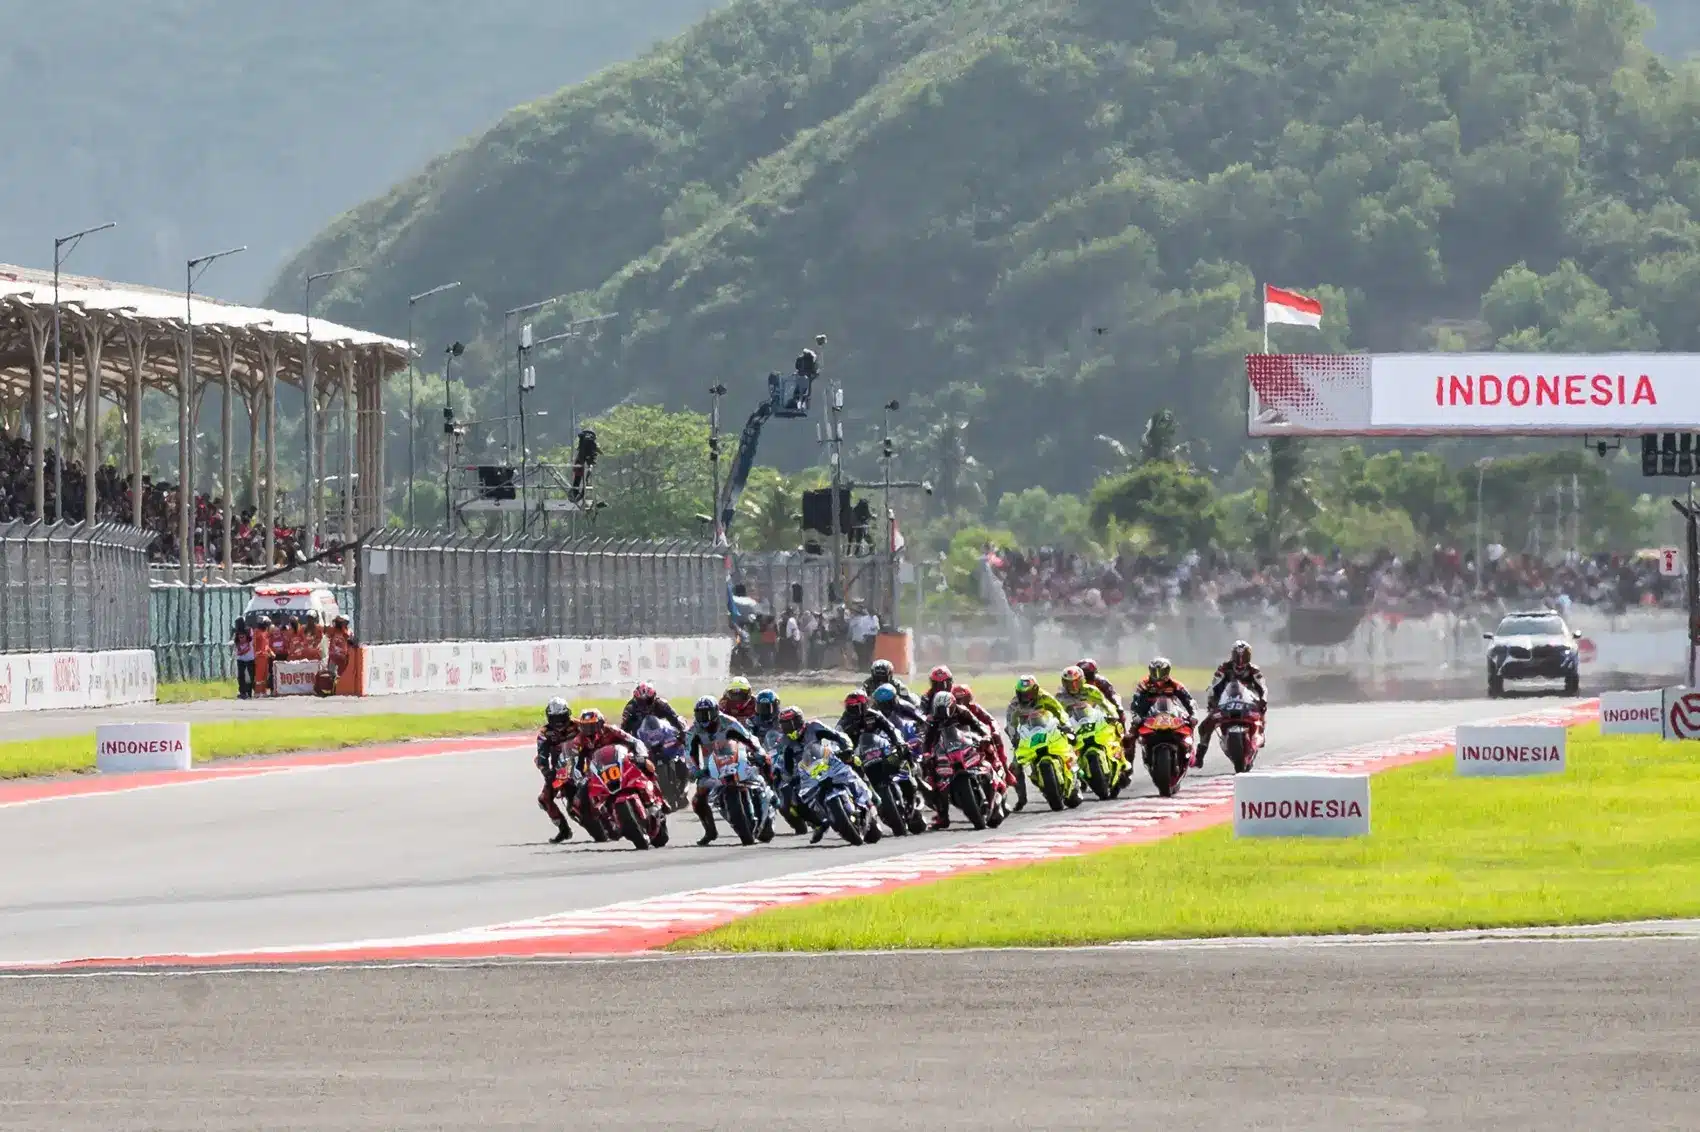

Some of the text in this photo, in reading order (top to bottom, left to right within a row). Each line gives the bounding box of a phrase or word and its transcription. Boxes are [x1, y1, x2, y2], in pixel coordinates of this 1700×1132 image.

[1436, 374, 1657, 406] INDONESIA
[1603, 707, 1664, 722] INDONE
[101, 740, 183, 754] INDONESIA
[1462, 745, 1560, 762] INDONESIA
[601, 765, 621, 785] 10
[1241, 799, 1362, 819] INDONESIA
